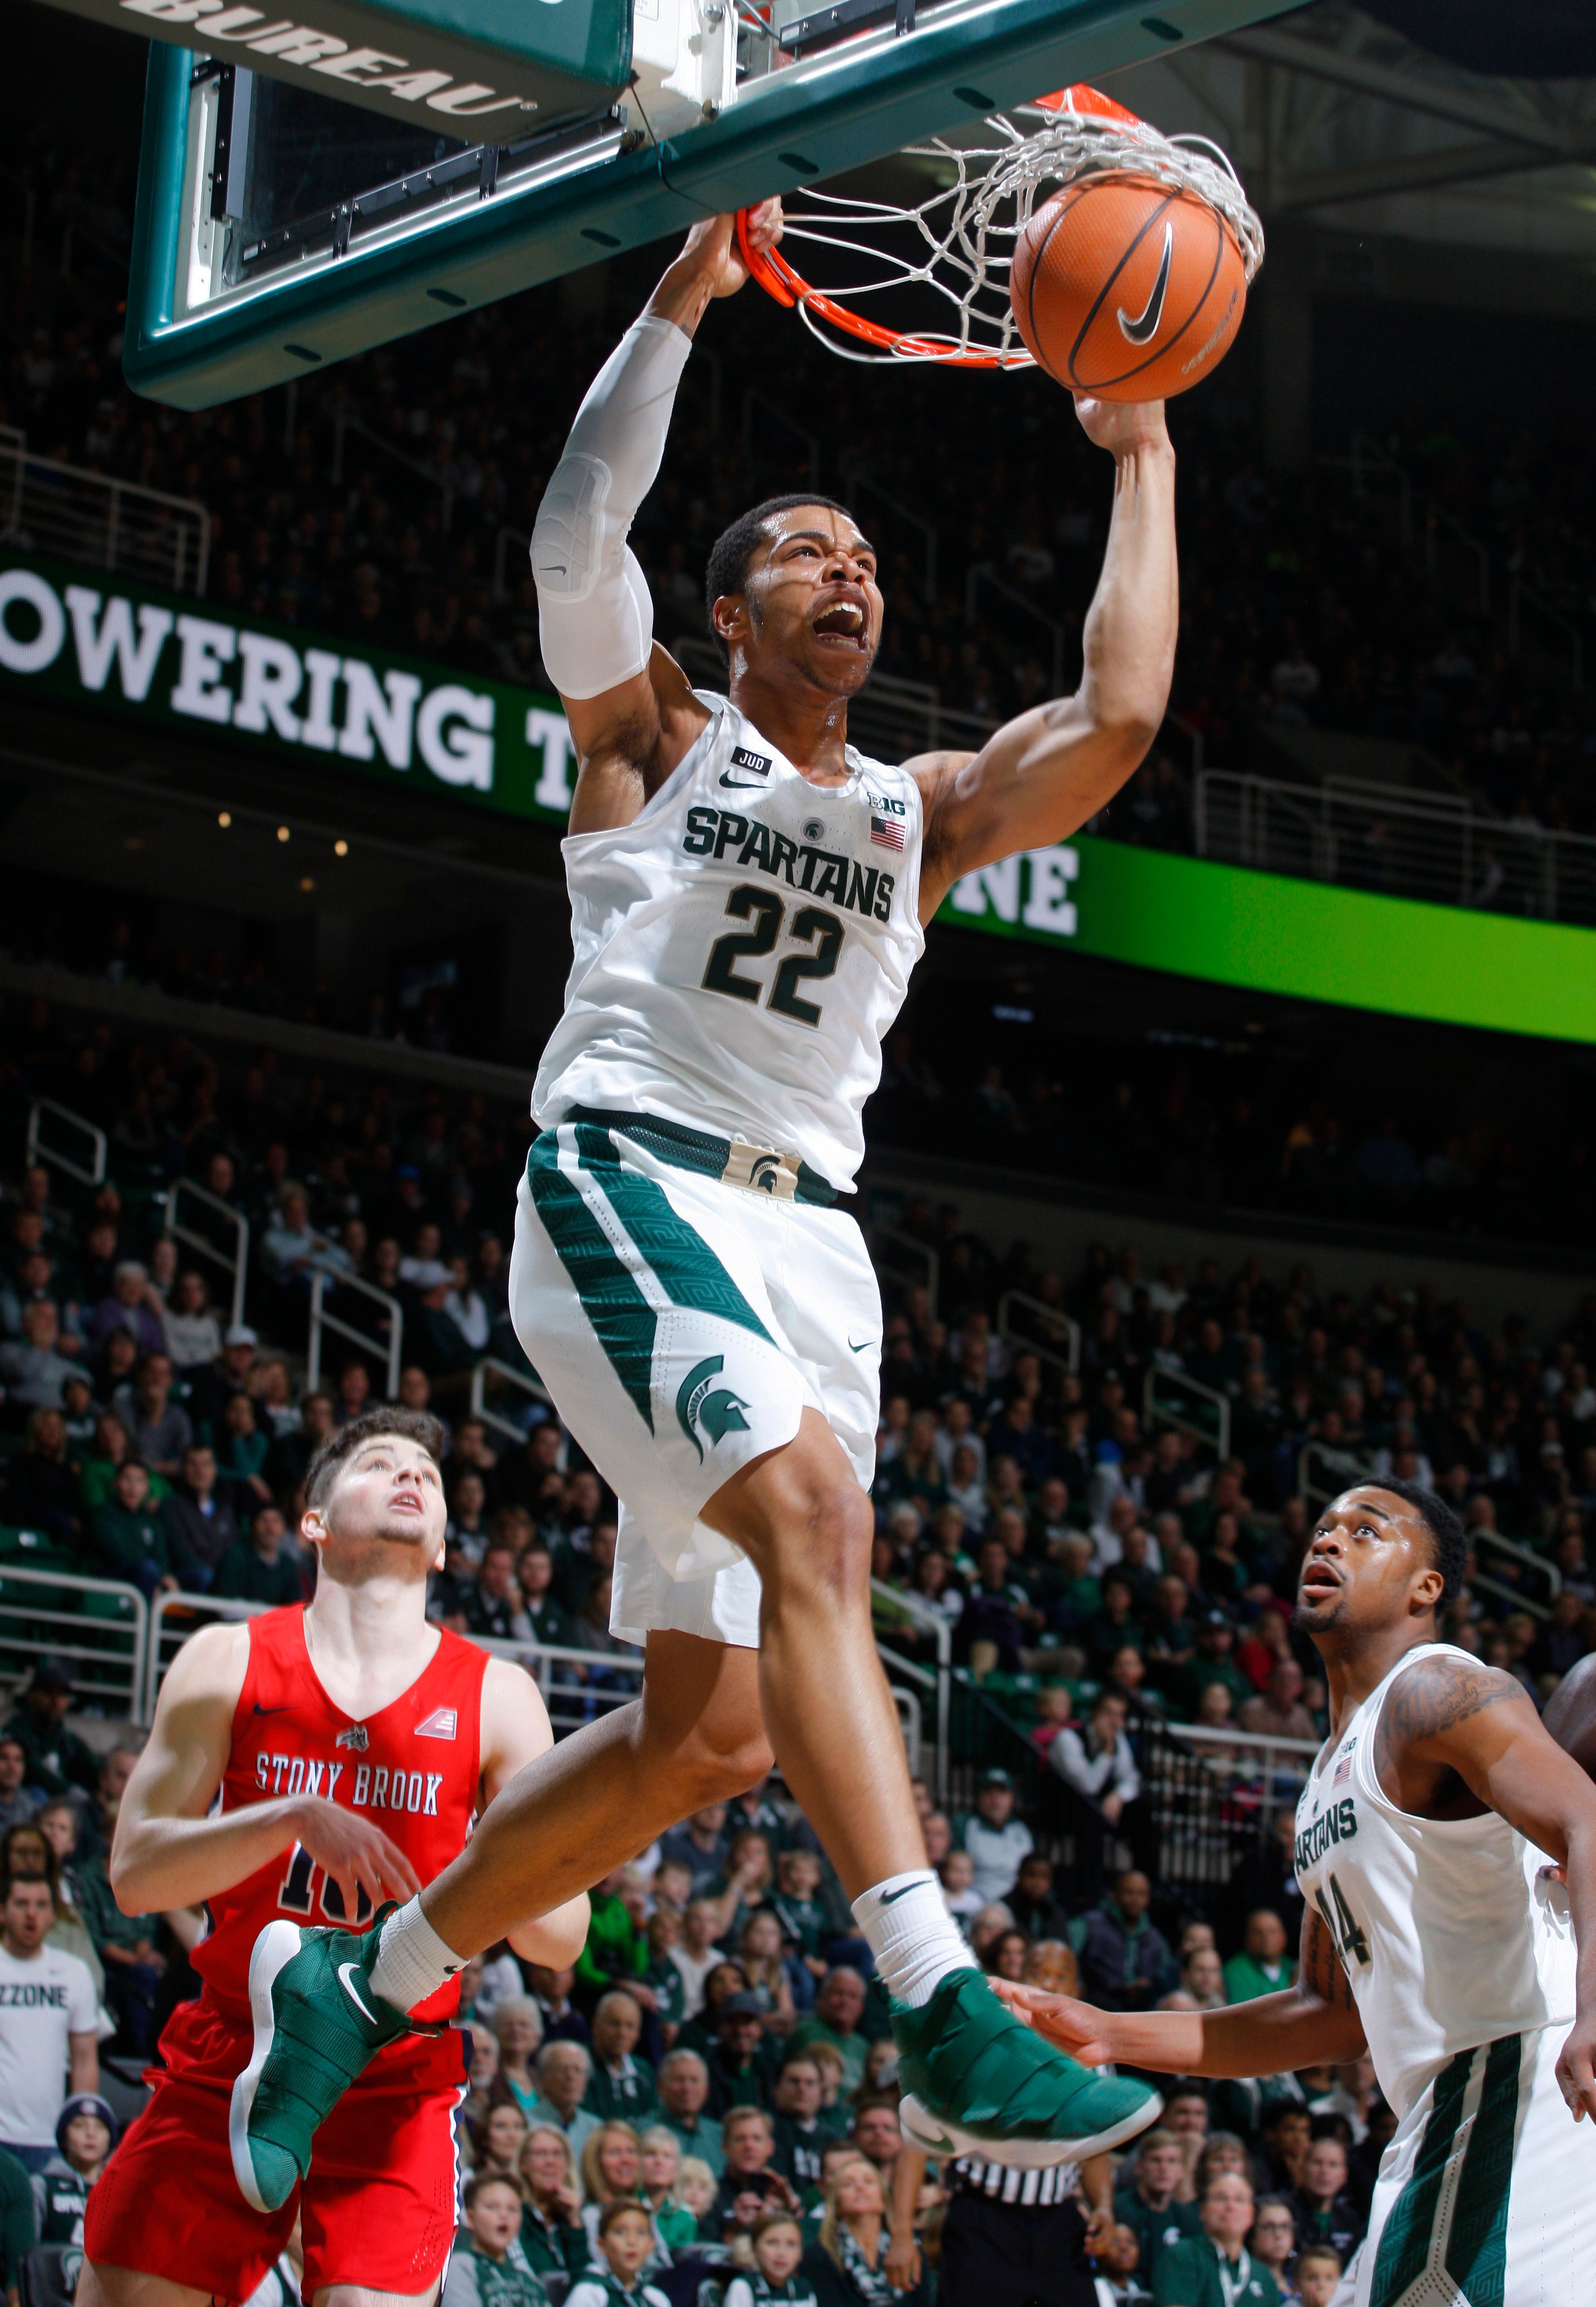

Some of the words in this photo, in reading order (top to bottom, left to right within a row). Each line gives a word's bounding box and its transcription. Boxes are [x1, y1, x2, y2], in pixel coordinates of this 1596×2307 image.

[0, 568, 495, 792] OWERING
[739, 751, 765, 770] JUD
[683, 806, 895, 923] SPARTANS
[701, 883, 846, 1028] 22
[255, 1751, 344, 1803] STONY
[352, 1763, 443, 1817] BROOK
